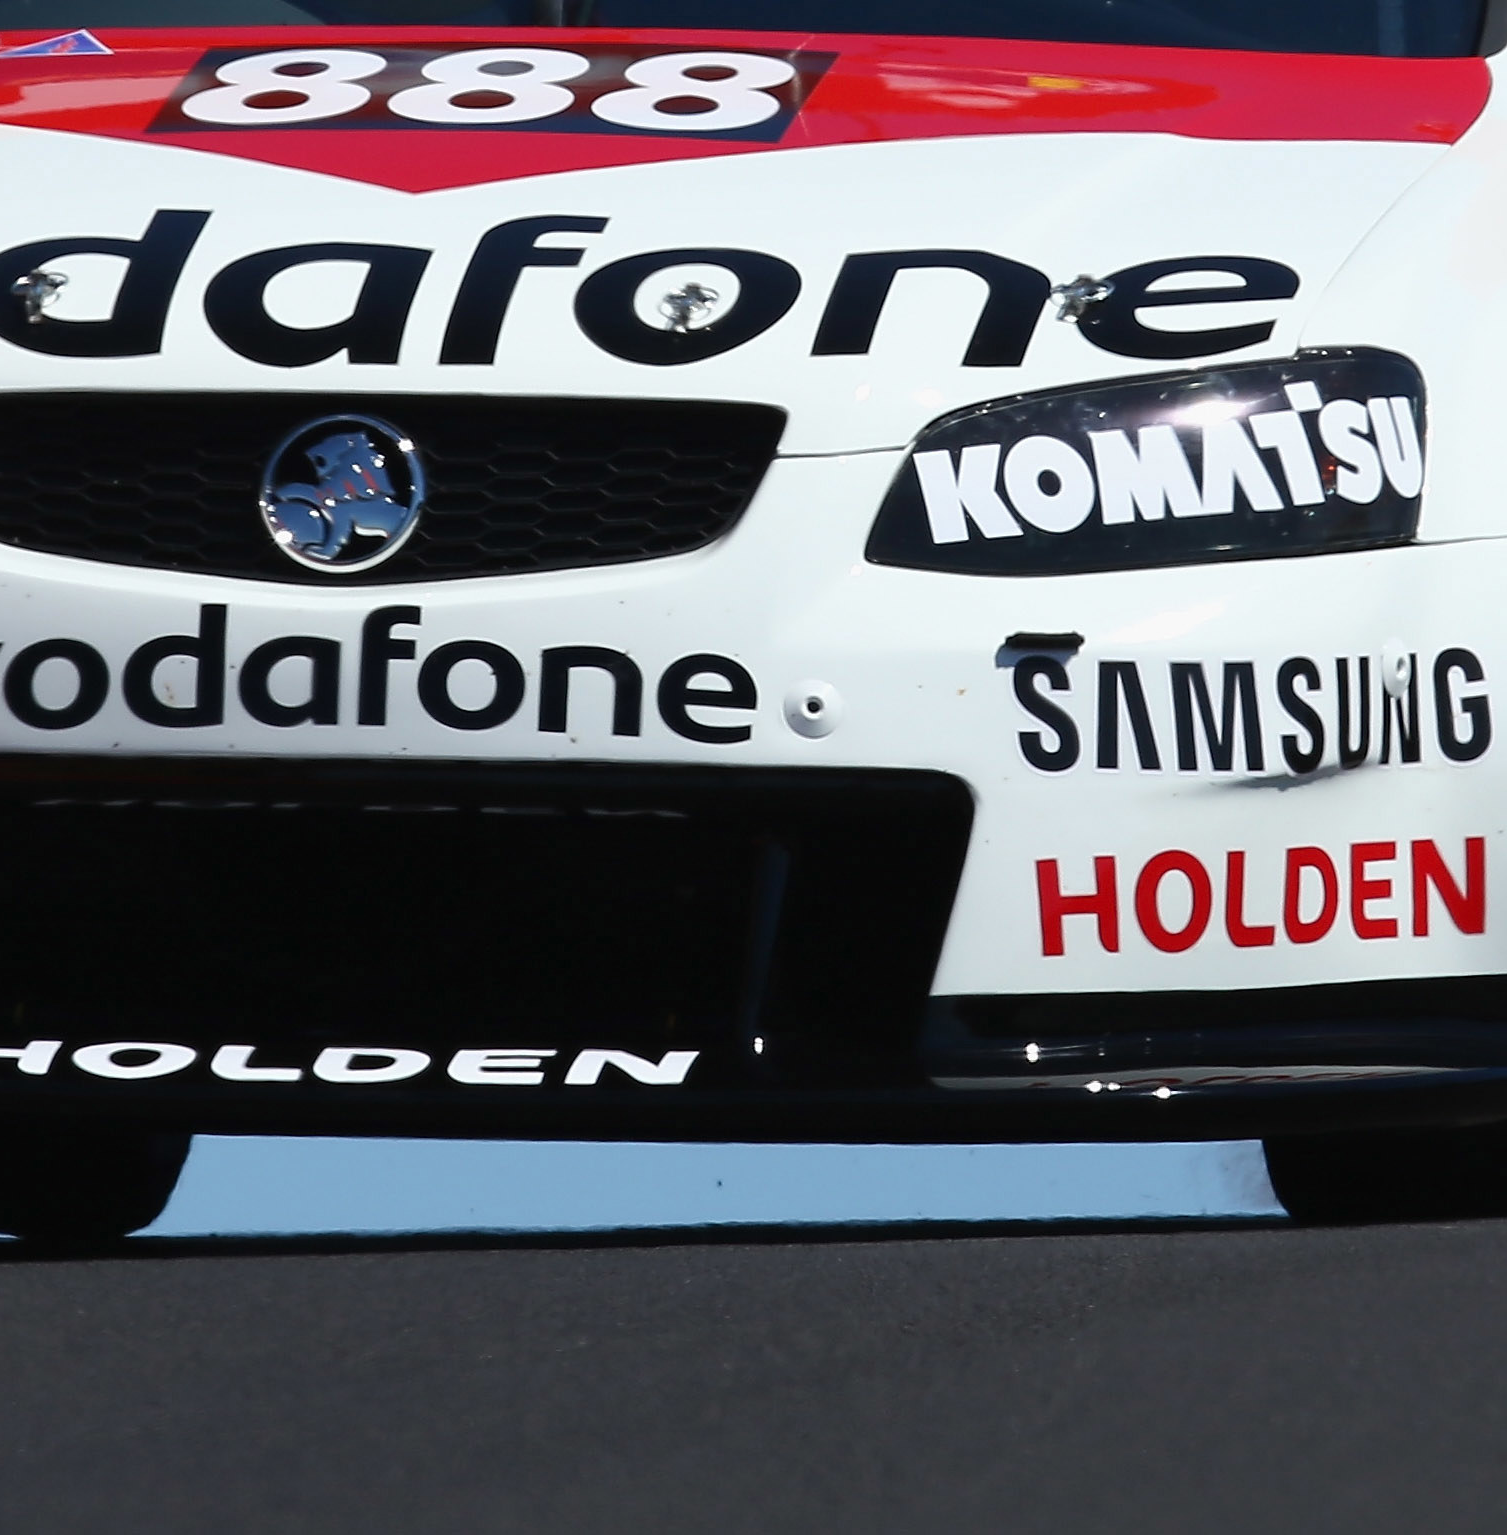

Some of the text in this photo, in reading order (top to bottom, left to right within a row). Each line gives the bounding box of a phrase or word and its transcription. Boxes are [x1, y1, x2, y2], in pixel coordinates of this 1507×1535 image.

[180, 48, 796, 131] 888
[911, 381, 1424, 545] KOMATSU
[1012, 648, 1493, 775] SAMSUNG
[1035, 837, 1487, 957] HOLDEN
